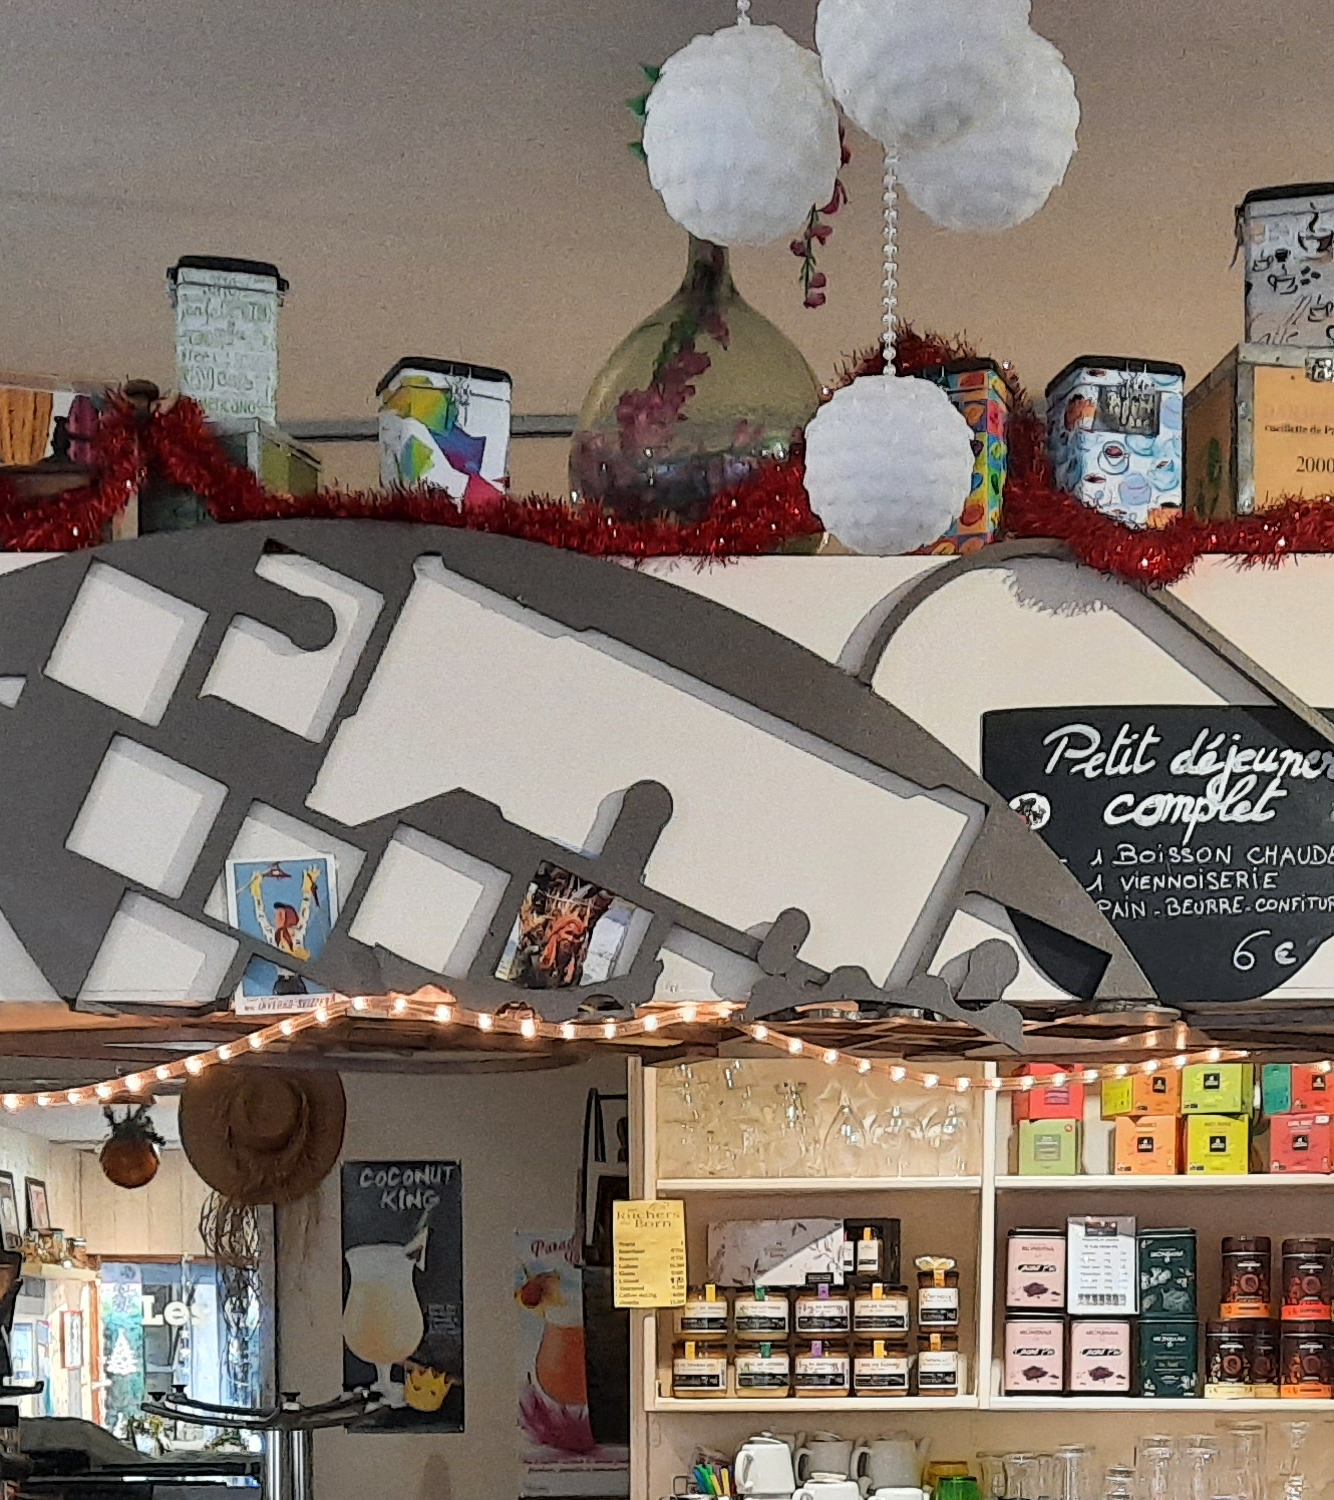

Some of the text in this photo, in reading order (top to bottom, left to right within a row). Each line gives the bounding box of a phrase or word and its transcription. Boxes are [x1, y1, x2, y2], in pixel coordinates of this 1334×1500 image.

[1042, 722, 1162, 780] Petit
[1103, 776, 1289, 845] complet
[359, 1163, 455, 1189] COCONUT
[379, 1187, 441, 1212] KING
